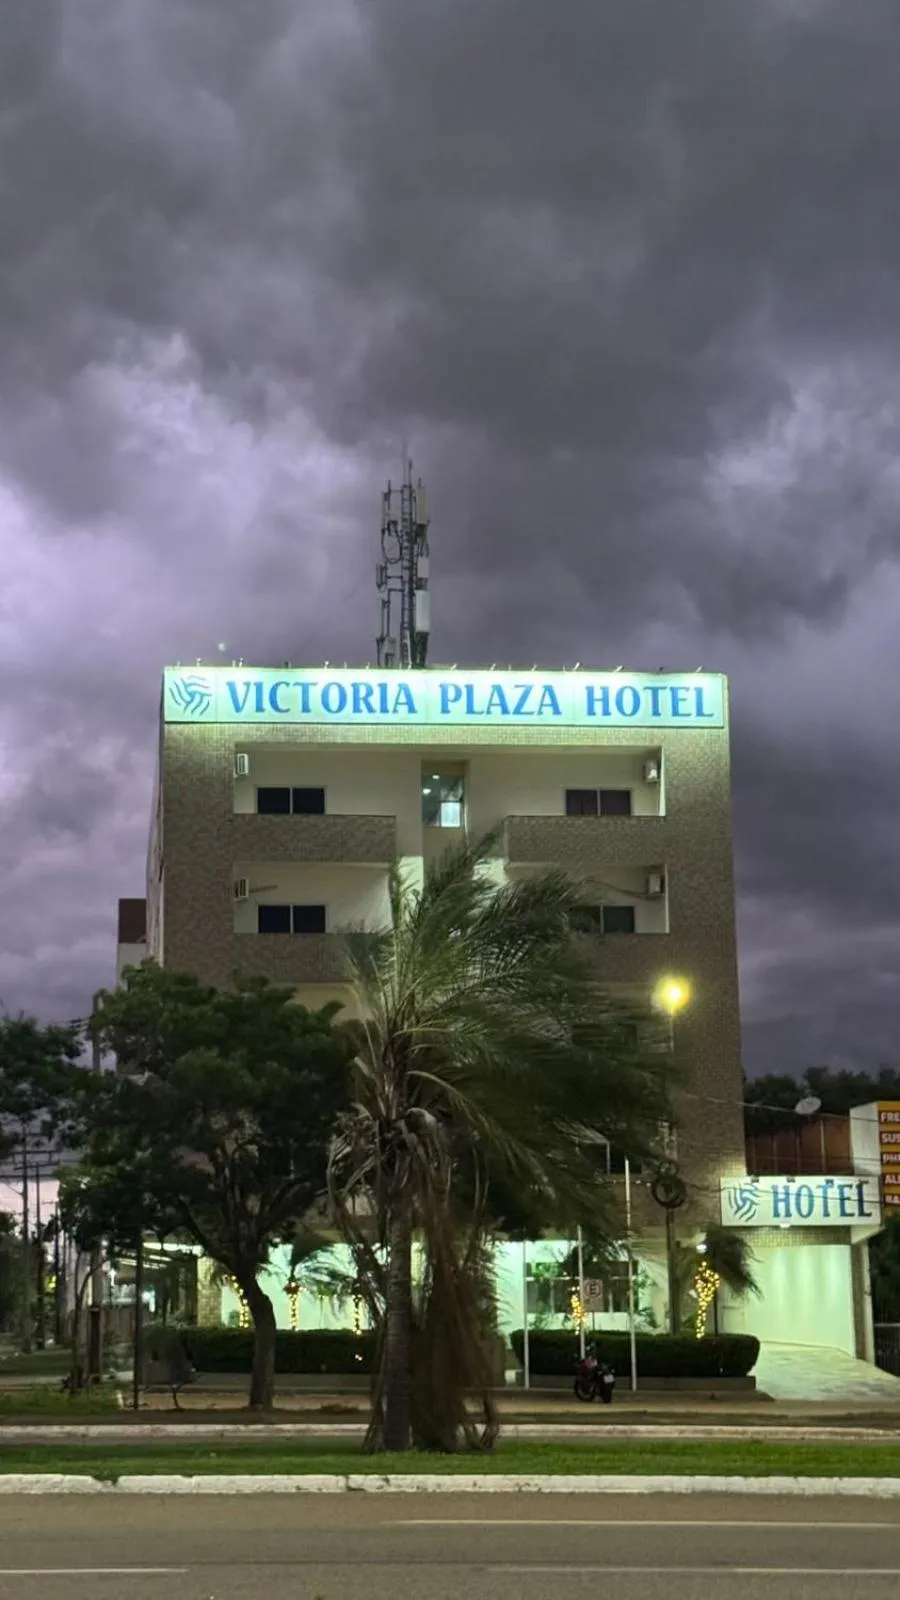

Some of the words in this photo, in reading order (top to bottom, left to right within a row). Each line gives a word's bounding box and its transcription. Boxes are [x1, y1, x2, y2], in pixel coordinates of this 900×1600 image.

[226, 681, 418, 714] VICTORIA
[439, 683, 562, 715] PLAZA
[585, 686, 714, 717] HOTEL
[771, 1179, 872, 1218] HOTEL
[590, 1283, 597, 1295] E
